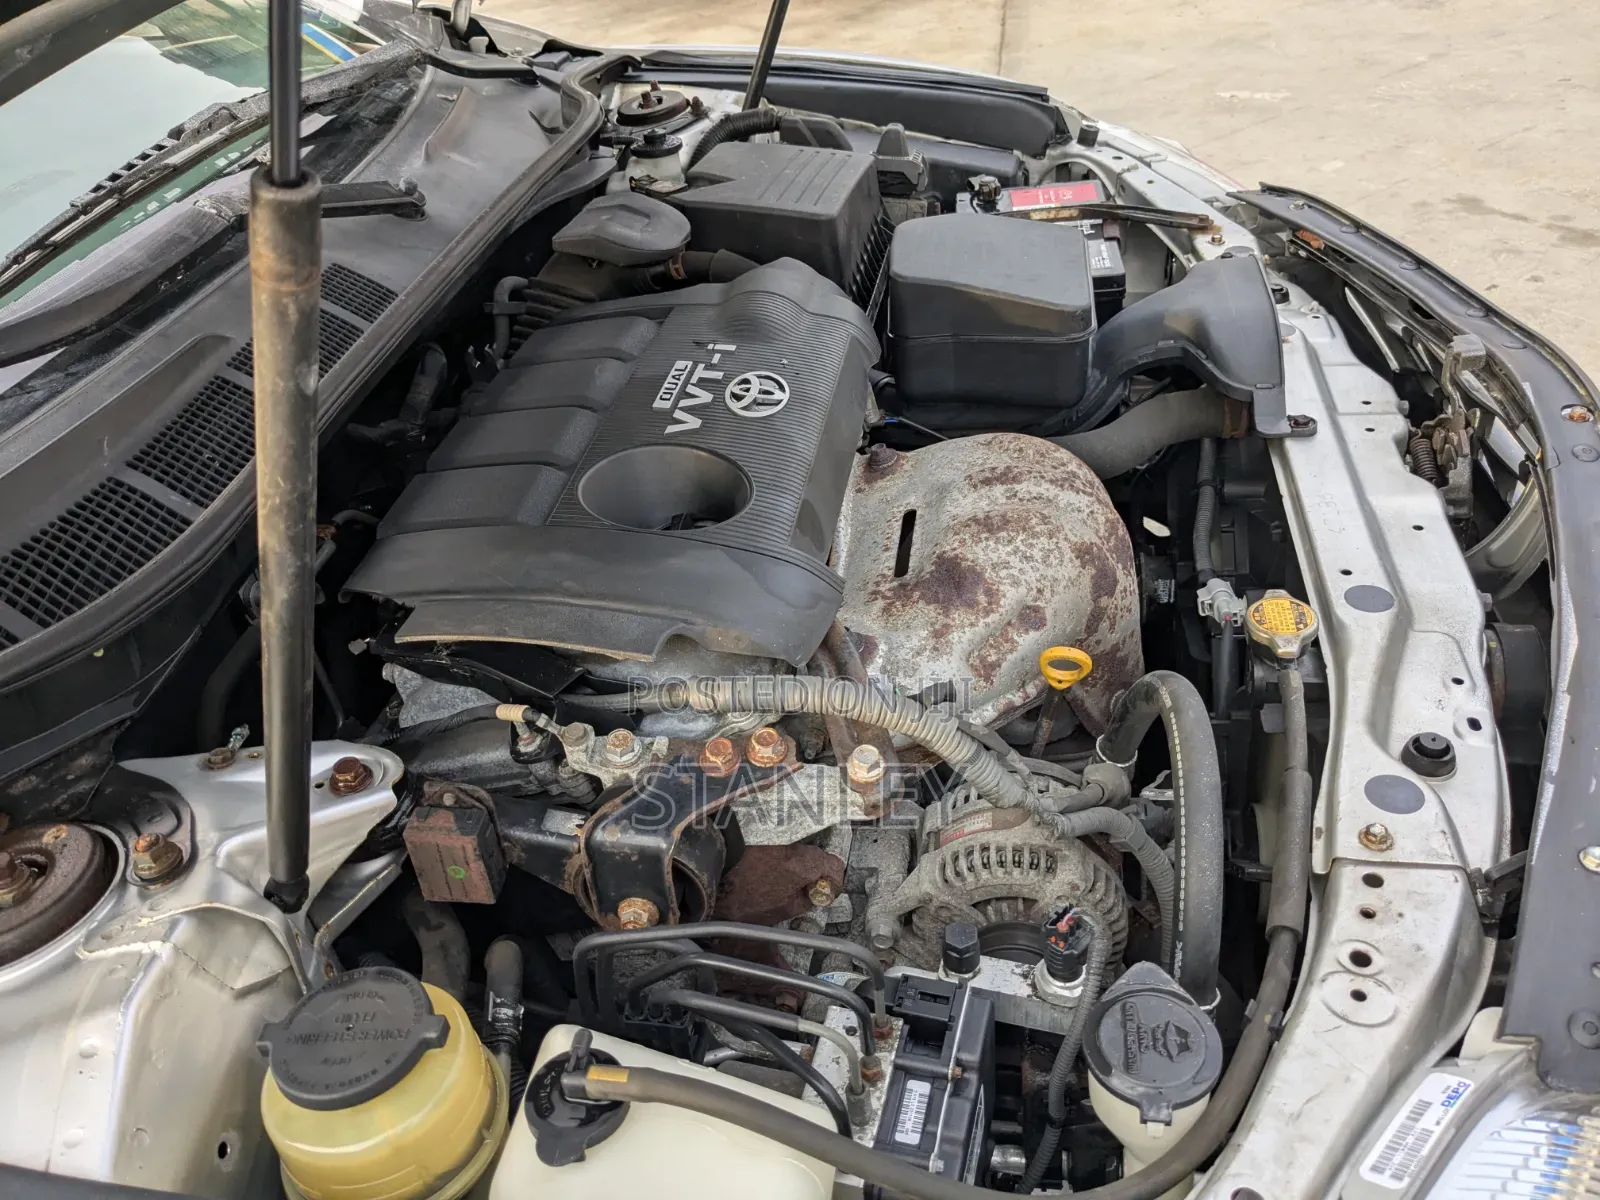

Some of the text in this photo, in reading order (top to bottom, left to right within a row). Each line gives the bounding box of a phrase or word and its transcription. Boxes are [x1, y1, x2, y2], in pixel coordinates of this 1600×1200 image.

[659, 363, 690, 402] DUAL
[664, 343, 737, 435] VVT-i
[337, 1011, 376, 1025] FLUID
[286, 1028, 410, 1046] POWER STEERING
[1124, 1002, 1139, 1073] WASHER FLUID
[1440, 1081, 1466, 1107] DEPO
